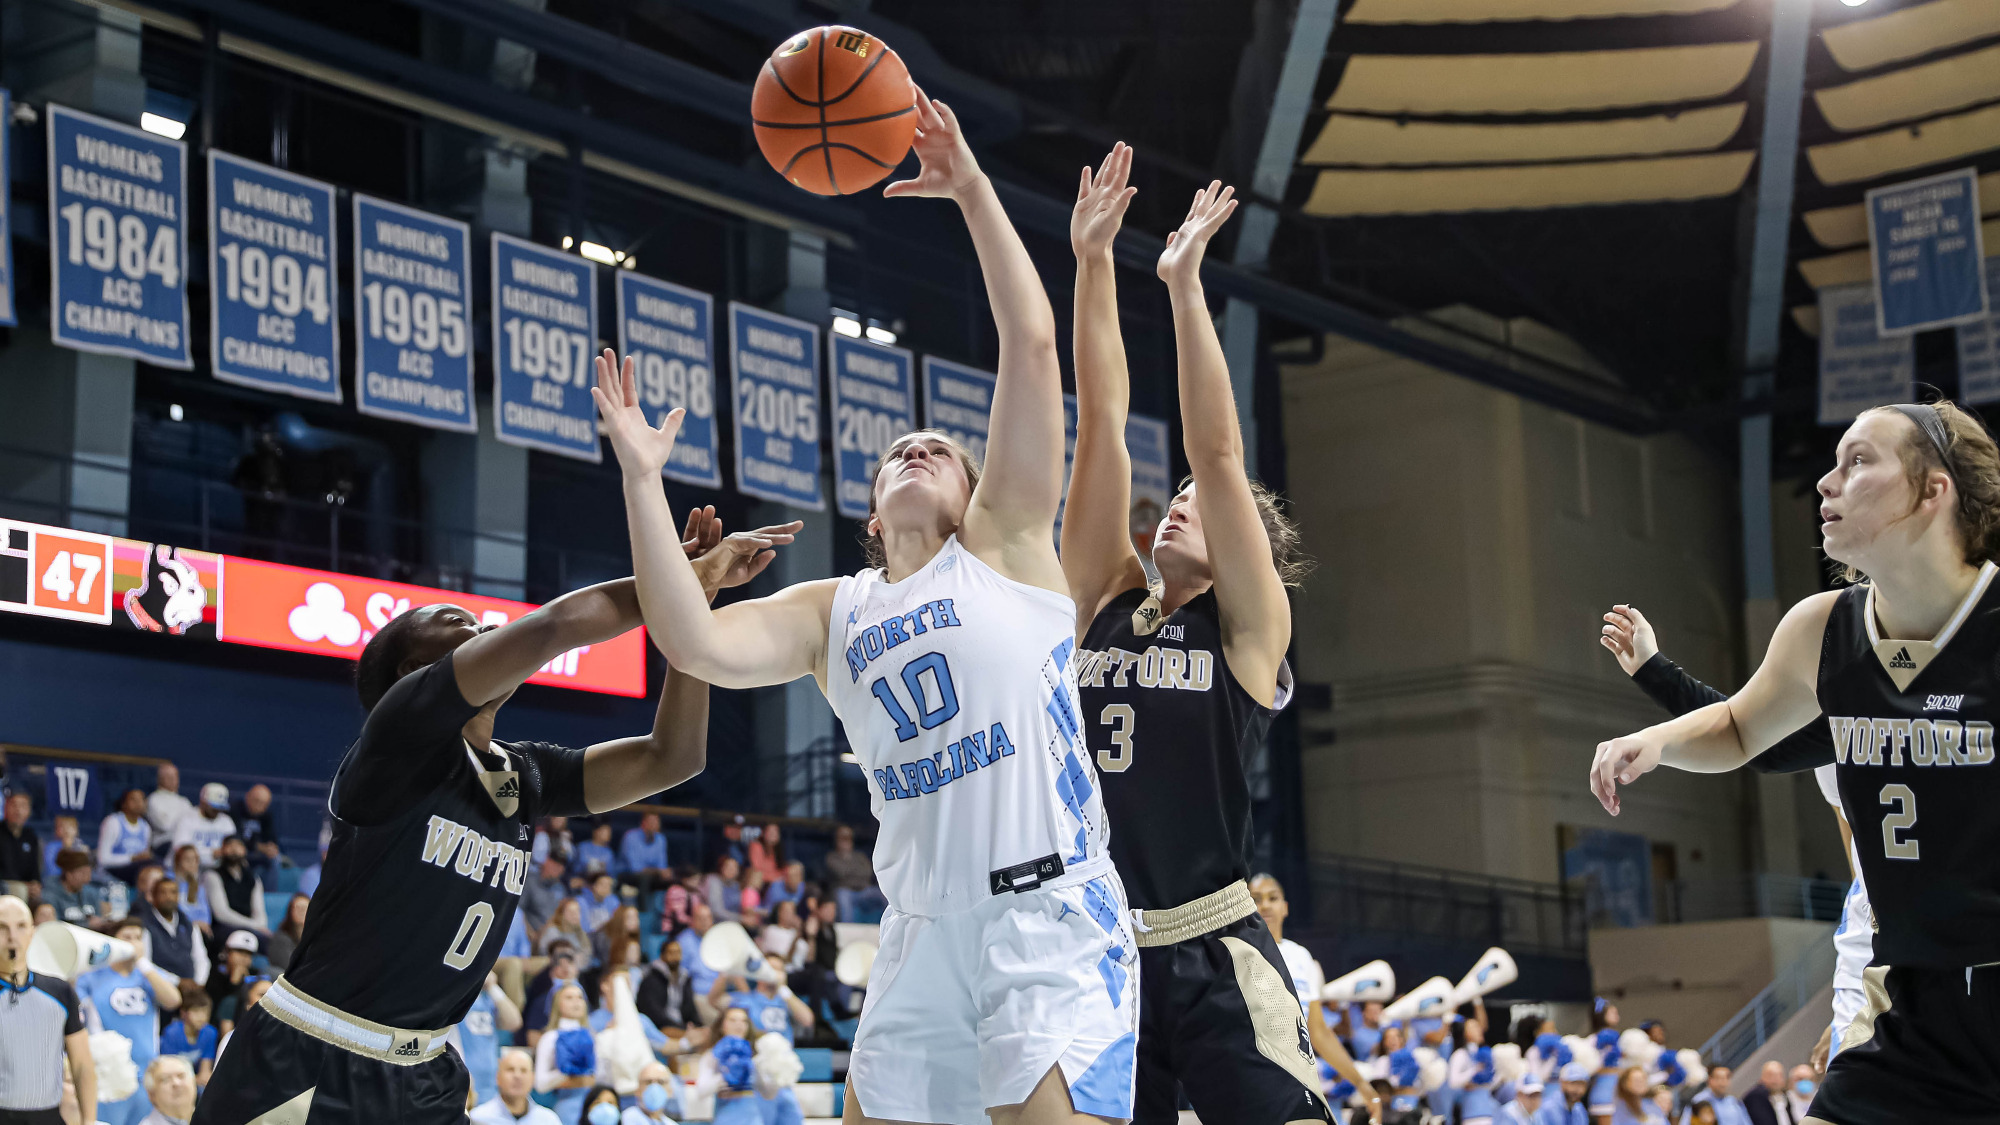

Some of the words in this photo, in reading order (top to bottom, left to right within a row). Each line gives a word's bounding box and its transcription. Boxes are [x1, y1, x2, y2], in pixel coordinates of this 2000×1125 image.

[75, 134, 163, 182] WOMEN'S
[62, 165, 175, 221] BASKETBALL
[233, 178, 314, 224] WOMEN'S
[61, 202, 179, 287] 1984
[220, 208, 325, 260] BASKETBALL
[102, 276, 143, 309] ACC
[219, 242, 331, 325] 1994
[65, 301, 180, 350] CHAMPIONS
[258, 314, 296, 343] ACC
[363, 282, 466, 358] 1995
[223, 337, 330, 383] CHAMPIONS
[398, 349, 434, 378] ACC
[503, 317, 589, 389] 1997
[367, 373, 465, 416] CHAMPIONS
[630, 349, 712, 418] 1998
[739, 378, 818, 444] 2005
[42, 550, 101, 604] 47
[846, 598, 962, 683] NORTH
[1157, 624, 1185, 642] CON
[1889, 659, 1916, 669] adidas
[870, 651, 960, 743] 10
[1923, 694, 1965, 712] SOCON
[1097, 703, 1135, 773] 3
[1828, 716, 1995, 766] WOFFORD
[54, 766, 89, 810] 117
[496, 789, 519, 798] adida
[1879, 783, 1920, 860] 2
[422, 814, 532, 895] WOFFO
[1041, 862, 1053, 873] 46
[443, 901, 495, 971] 0
[395, 1048, 420, 1056] adidas
